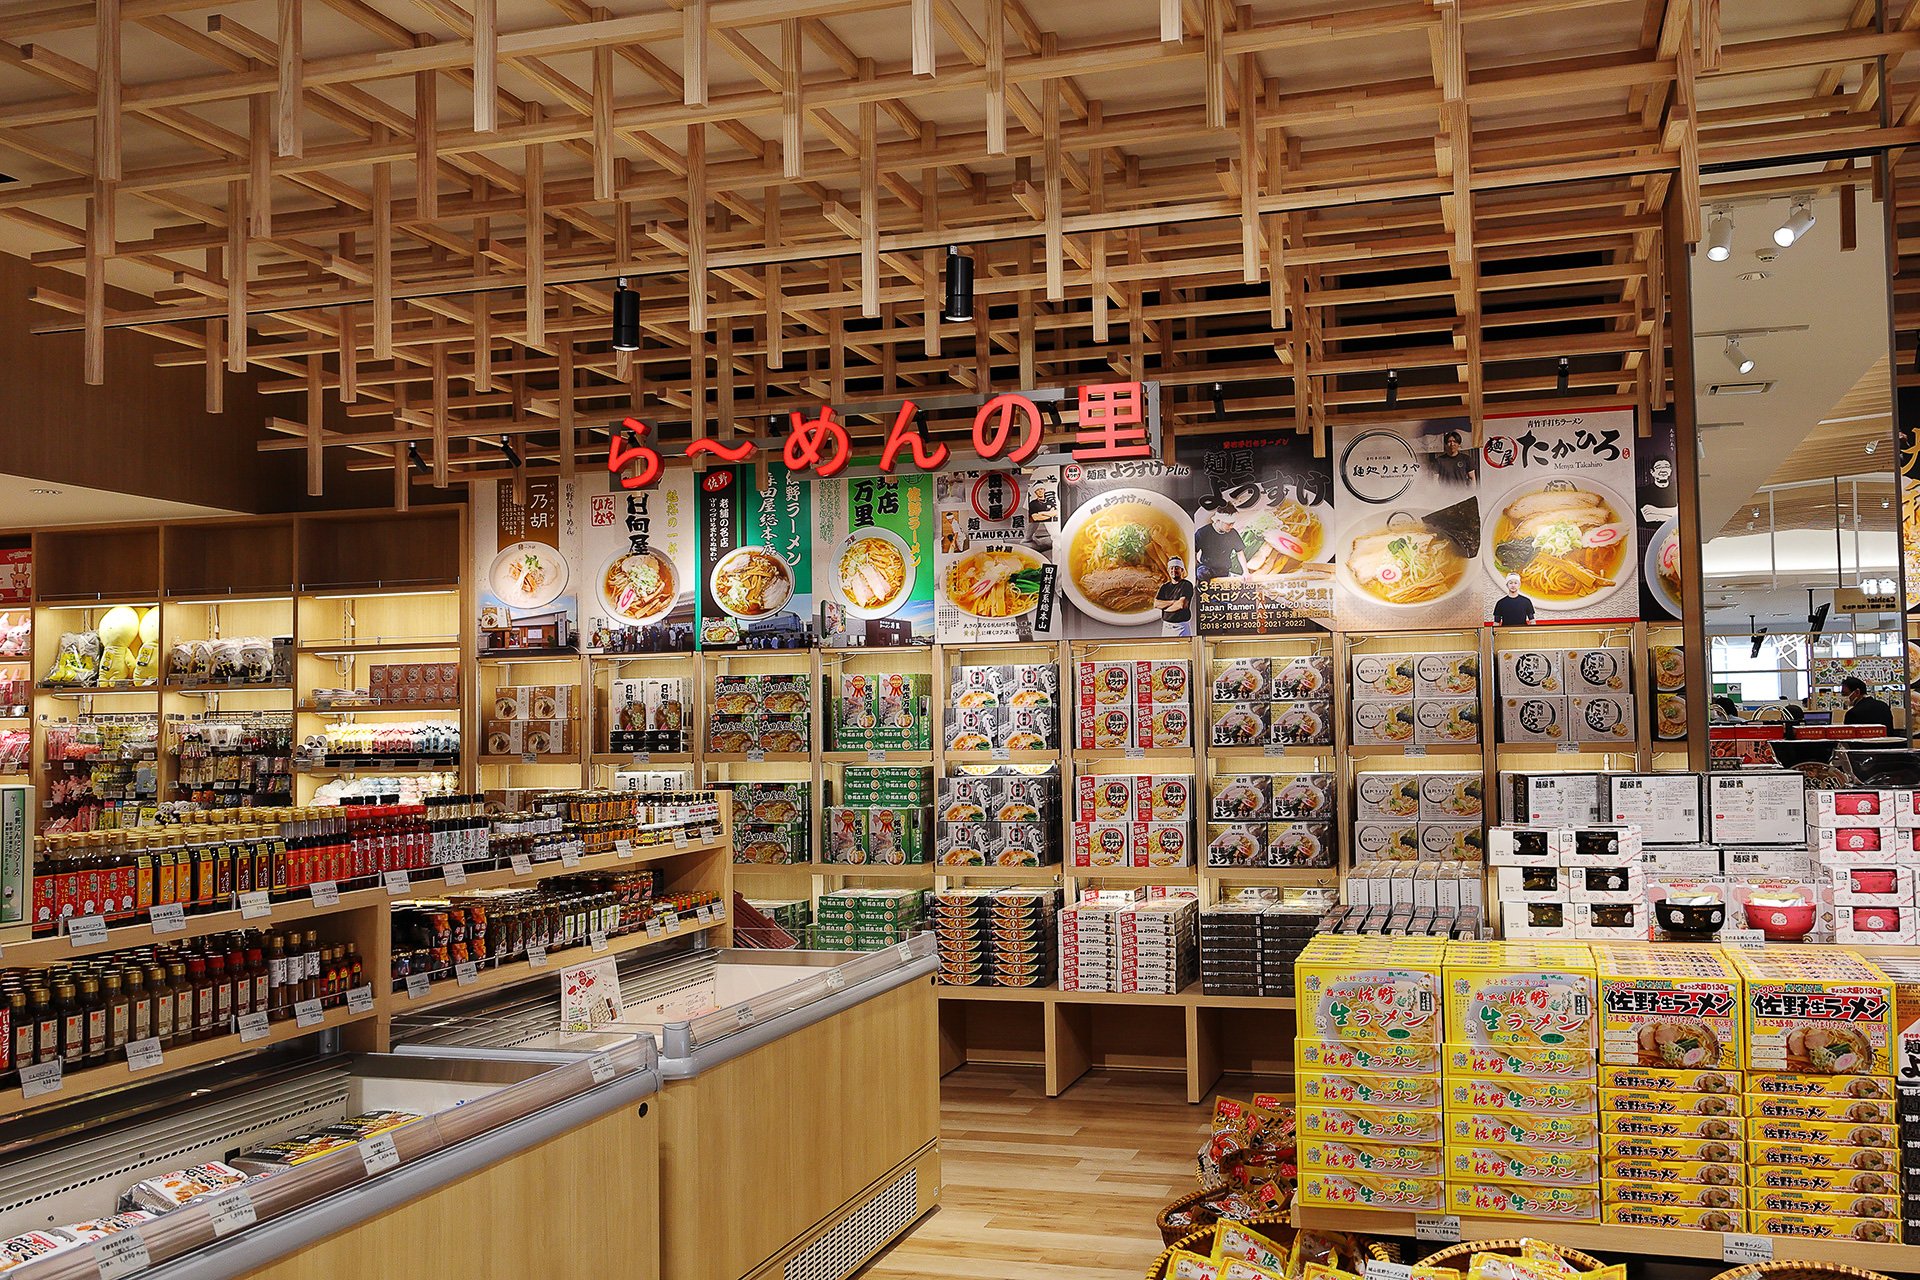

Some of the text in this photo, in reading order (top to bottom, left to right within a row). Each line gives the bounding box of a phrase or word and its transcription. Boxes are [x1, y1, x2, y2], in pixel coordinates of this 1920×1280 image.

[1485, 437, 1514, 467] 麺屋
[1516, 430, 1621, 469] たかひろ
[1086, 468, 1107, 480] 麺屋
[1110, 460, 1164, 479] ようすけ
[1203, 450, 1255, 475] 麺屋
[1554, 461, 1603, 471] Menya Takahiro
[707, 472, 728, 489] 佐野
[988, 473, 1003, 520] 田村屋
[1198, 470, 1333, 510] ようすけ
[529, 484, 549, 529] 一乃胡
[853, 479, 876, 527] 万里
[907, 487, 922, 568] 佐野ラーメン
[968, 530, 1025, 540] TAMURAYA
[1200, 604, 1225, 612] Japan
[1227, 602, 1255, 611] Ramen
[1257, 600, 1286, 610] Award
[1251, 611, 1275, 620] EAST
[1214, 689, 1250, 700] ようすけ
[1273, 688, 1309, 699] ようすけ
[1214, 733, 1250, 744] ようすけ
[1272, 732, 1309, 744] ようすけ
[1214, 808, 1250, 818] ようすけ
[1273, 807, 1310, 818] ようすけ
[1209, 853, 1246, 866] ようすけ
[1268, 853, 1307, 865] ようすけ
[1357, 985, 1398, 1006] 佐野
[1508, 988, 1552, 1010] 佐野
[1604, 990, 1736, 1017] 佐野生ラーメン
[1328, 1001, 1431, 1028] 生ラーメン
[1754, 994, 1890, 1021] 佐野生ラーメン
[1480, 1005, 1586, 1032] 生ラーメン
[1614, 1075, 1676, 1090] 佐野生ラーメン
[1760, 1080, 1825, 1096] 佐野生ラーメン
[1615, 1098, 1677, 1113] 佐野生ラーメン
[1761, 1103, 1826, 1119] 佐野生ラーメン
[1617, 1121, 1679, 1137] 佐野生ラーメン
[1763, 1126, 1829, 1143] 佐野生ラーメン
[1617, 1143, 1680, 1159] 佐野生ラーメン
[1766, 1151, 1831, 1168] 佐野生ラーメン
[1617, 1165, 1679, 1181] 佐野生ラーメン
[1766, 1174, 1831, 1190] 佐野生ラーメン
[1617, 1188, 1680, 1204] 佐野生ラーメン
[1766, 1197, 1831, 1214] 佐野生ラーメン
[1617, 1211, 1680, 1227] 佐野生ラーメン
[1766, 1220, 1833, 1238] 佐野生ラーメン
